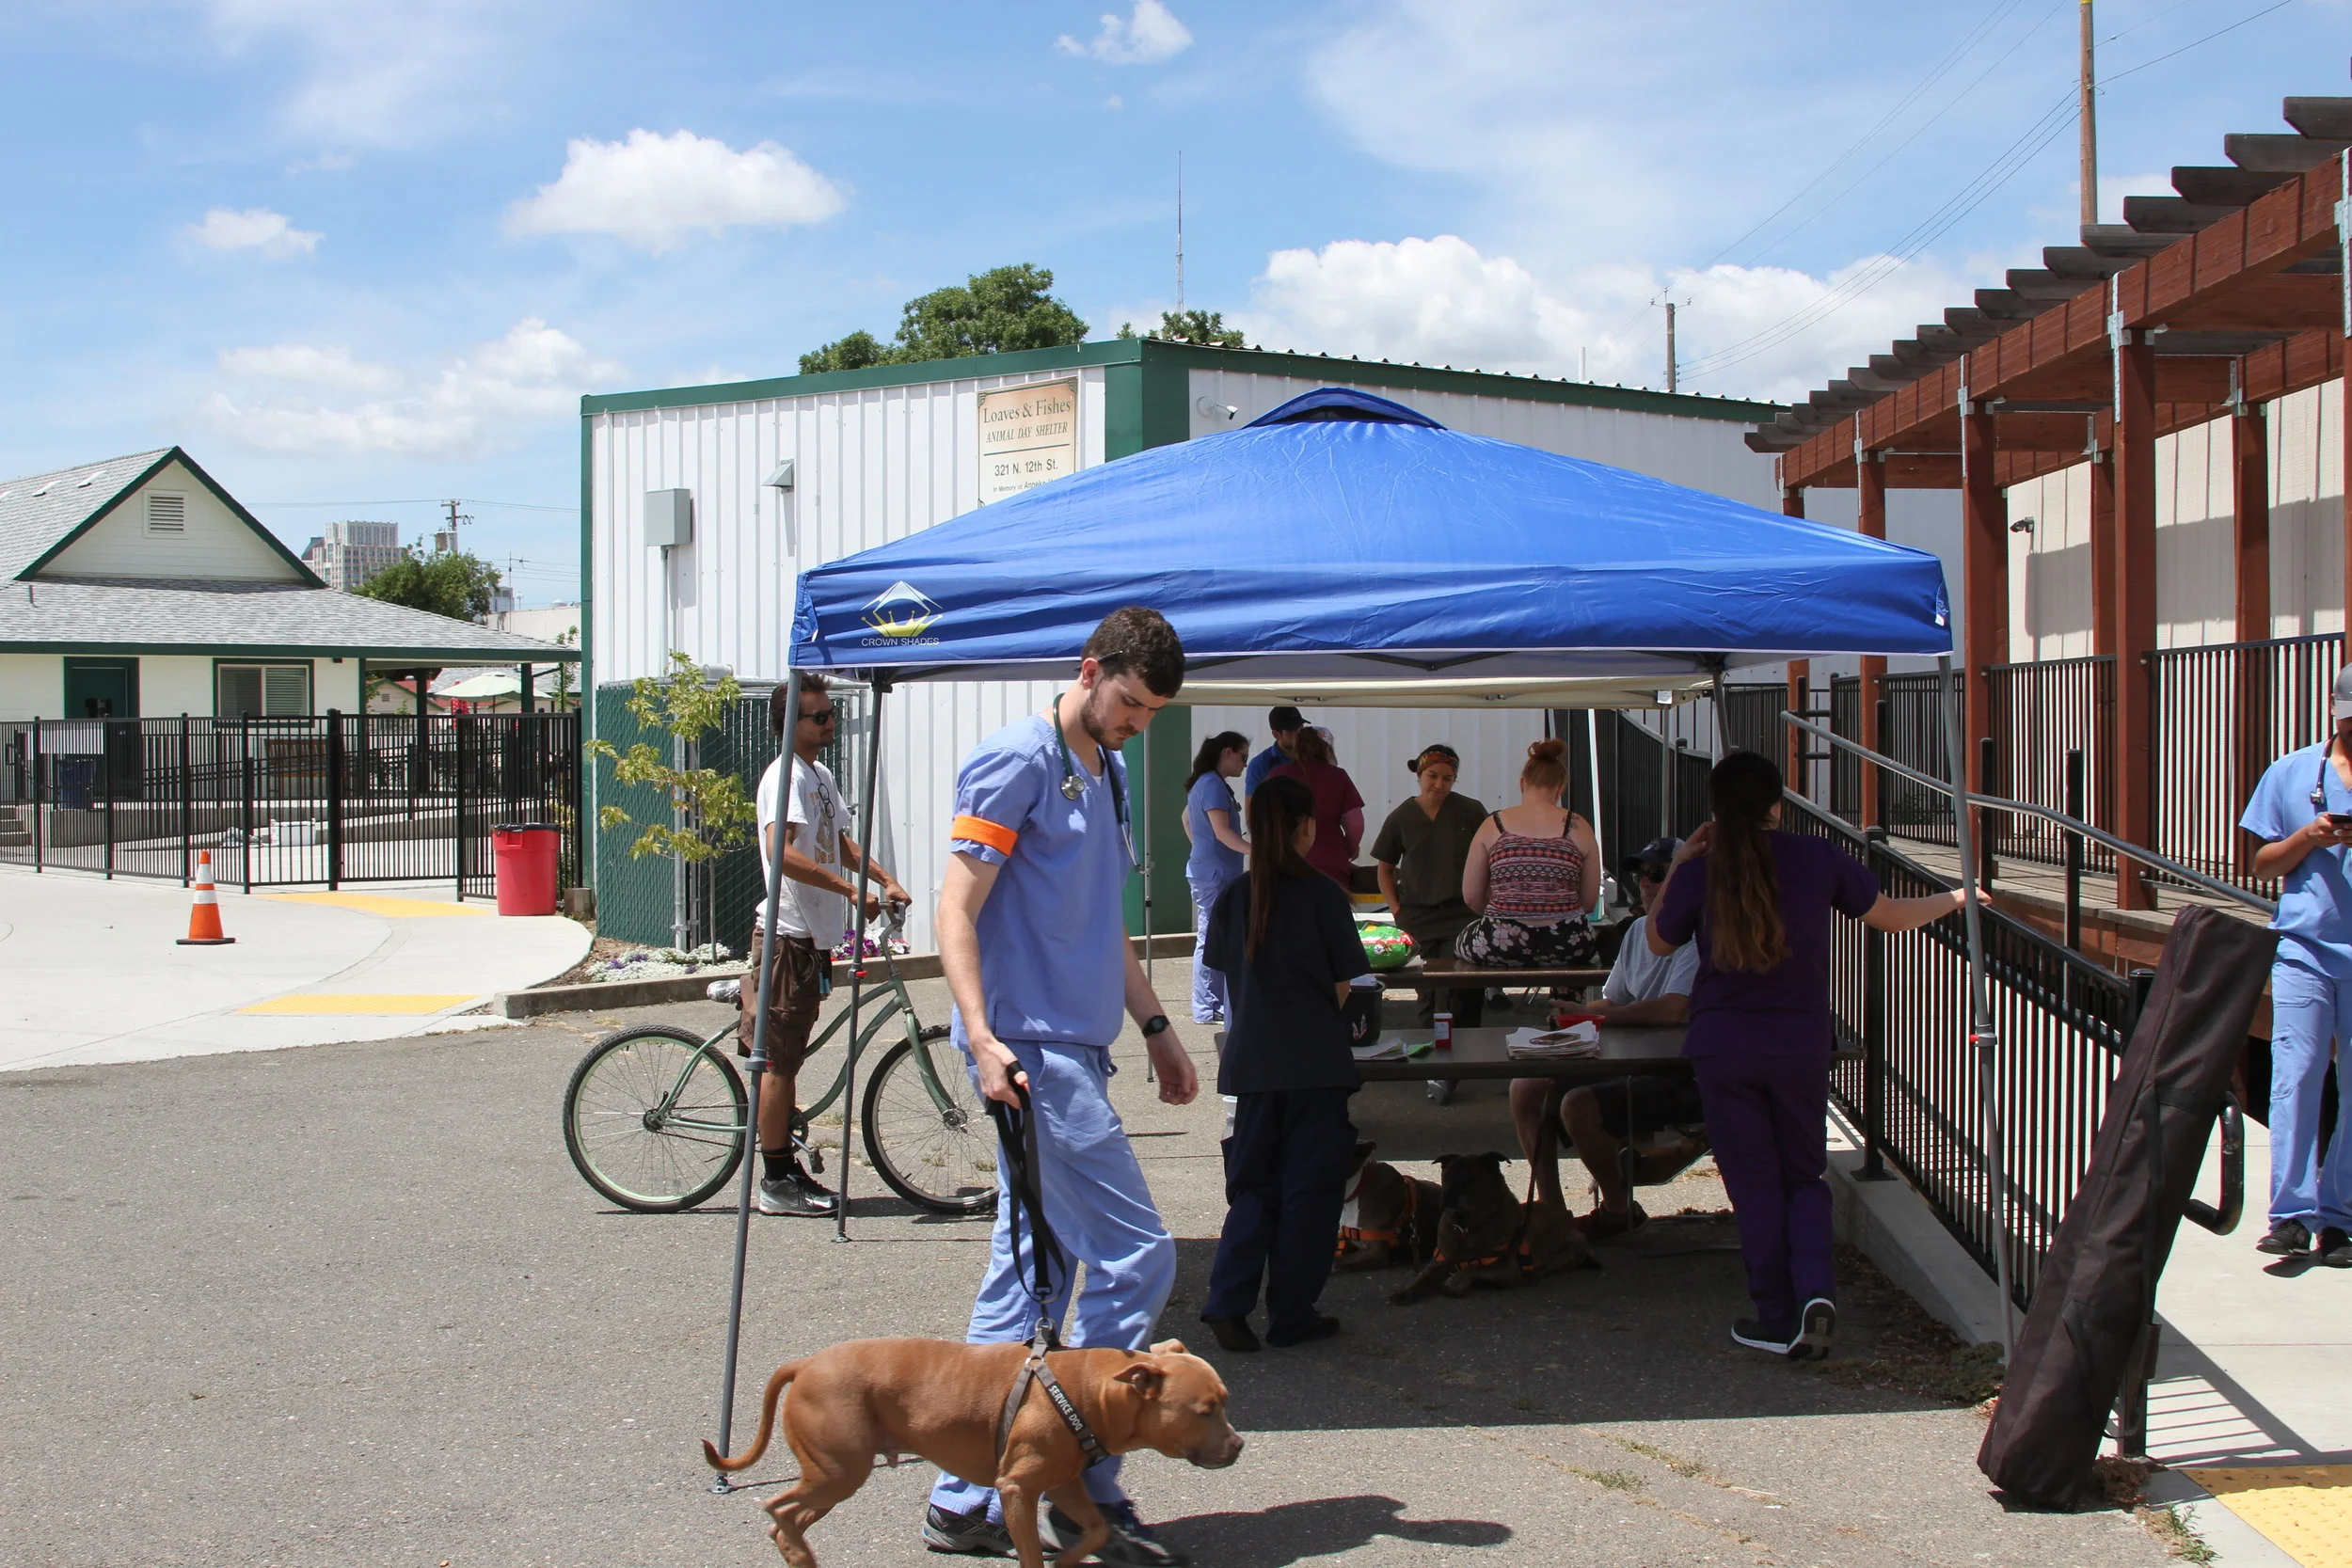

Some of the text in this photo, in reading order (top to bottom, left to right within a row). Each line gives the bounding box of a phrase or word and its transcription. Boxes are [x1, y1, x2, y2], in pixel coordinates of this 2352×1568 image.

[983, 397, 1071, 423] Loaves & Fishes
[986, 421, 1068, 443] ANIMAL DAY SHELTER
[994, 458, 1057, 476] 321 N. 12th St.
[861, 637, 940, 647] CROWN SHADES
[1048, 1385, 1084, 1432] SERVICE DOG
